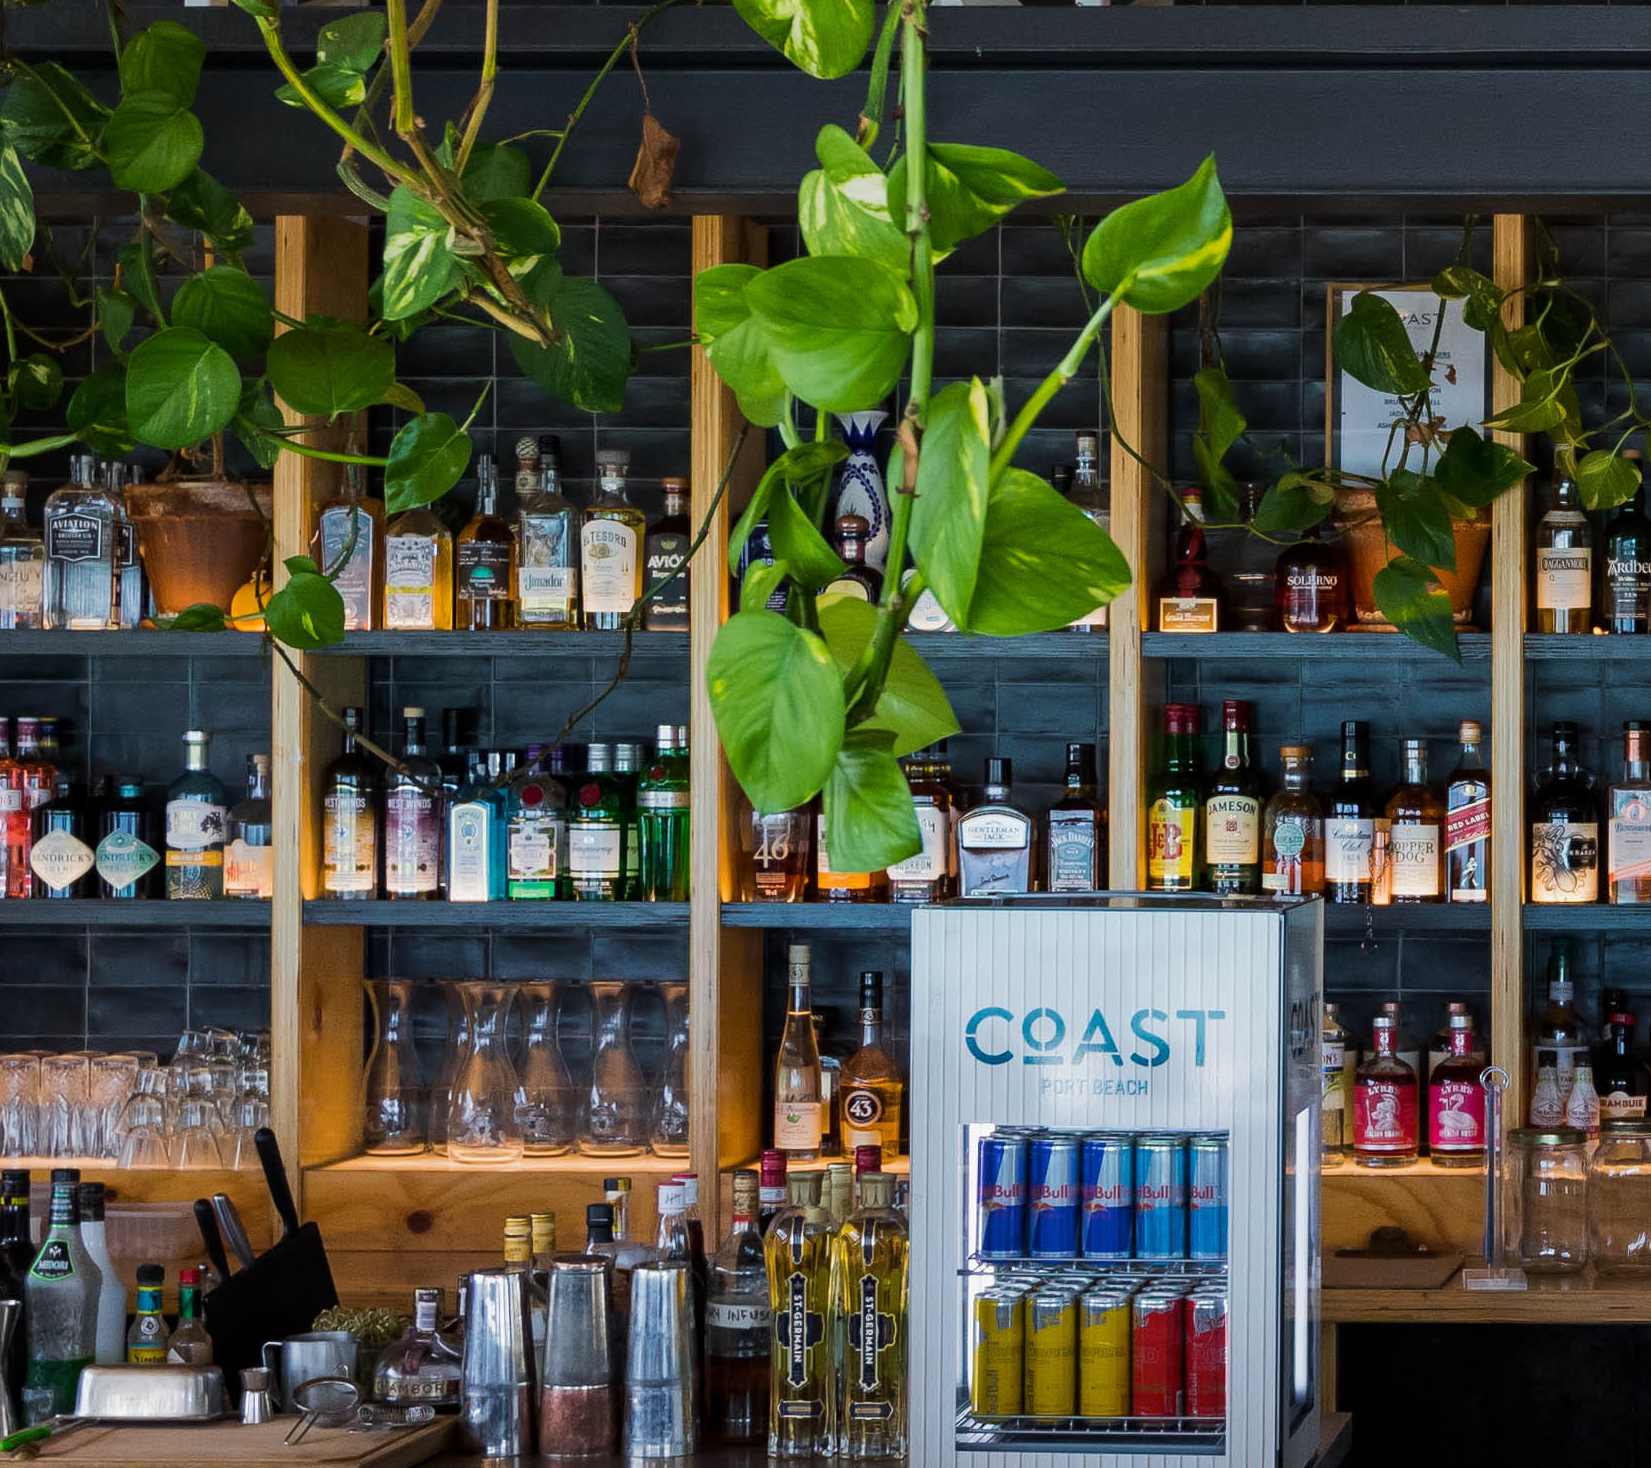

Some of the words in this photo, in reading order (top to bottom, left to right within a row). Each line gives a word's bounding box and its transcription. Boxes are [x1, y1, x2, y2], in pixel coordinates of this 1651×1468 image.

[52, 519, 97, 530] AVIATION
[591, 530, 627, 548] TESORO
[1287, 574, 1338, 586] SOLERNO
[1208, 801, 1257, 817] JAMESON
[967, 826, 1019, 835] GENTLEMAN
[1448, 821, 1464, 833] RED
[1465, 812, 1490, 828] LABEL
[754, 834, 789, 868] 46
[1395, 852, 1425, 864] DOG
[965, 1007, 1226, 1068] COAST
[1040, 1079, 1087, 1096] PORT
[1093, 1079, 1148, 1096] BEACH
[850, 1100, 872, 1117] 43
[1599, 1098, 1644, 1109] RAMBUIE
[38, 1260, 69, 1270] MIDORI
[793, 1295, 802, 1363] ST-GERMAIN
[865, 1296, 874, 1365] ST-GERMAIN
